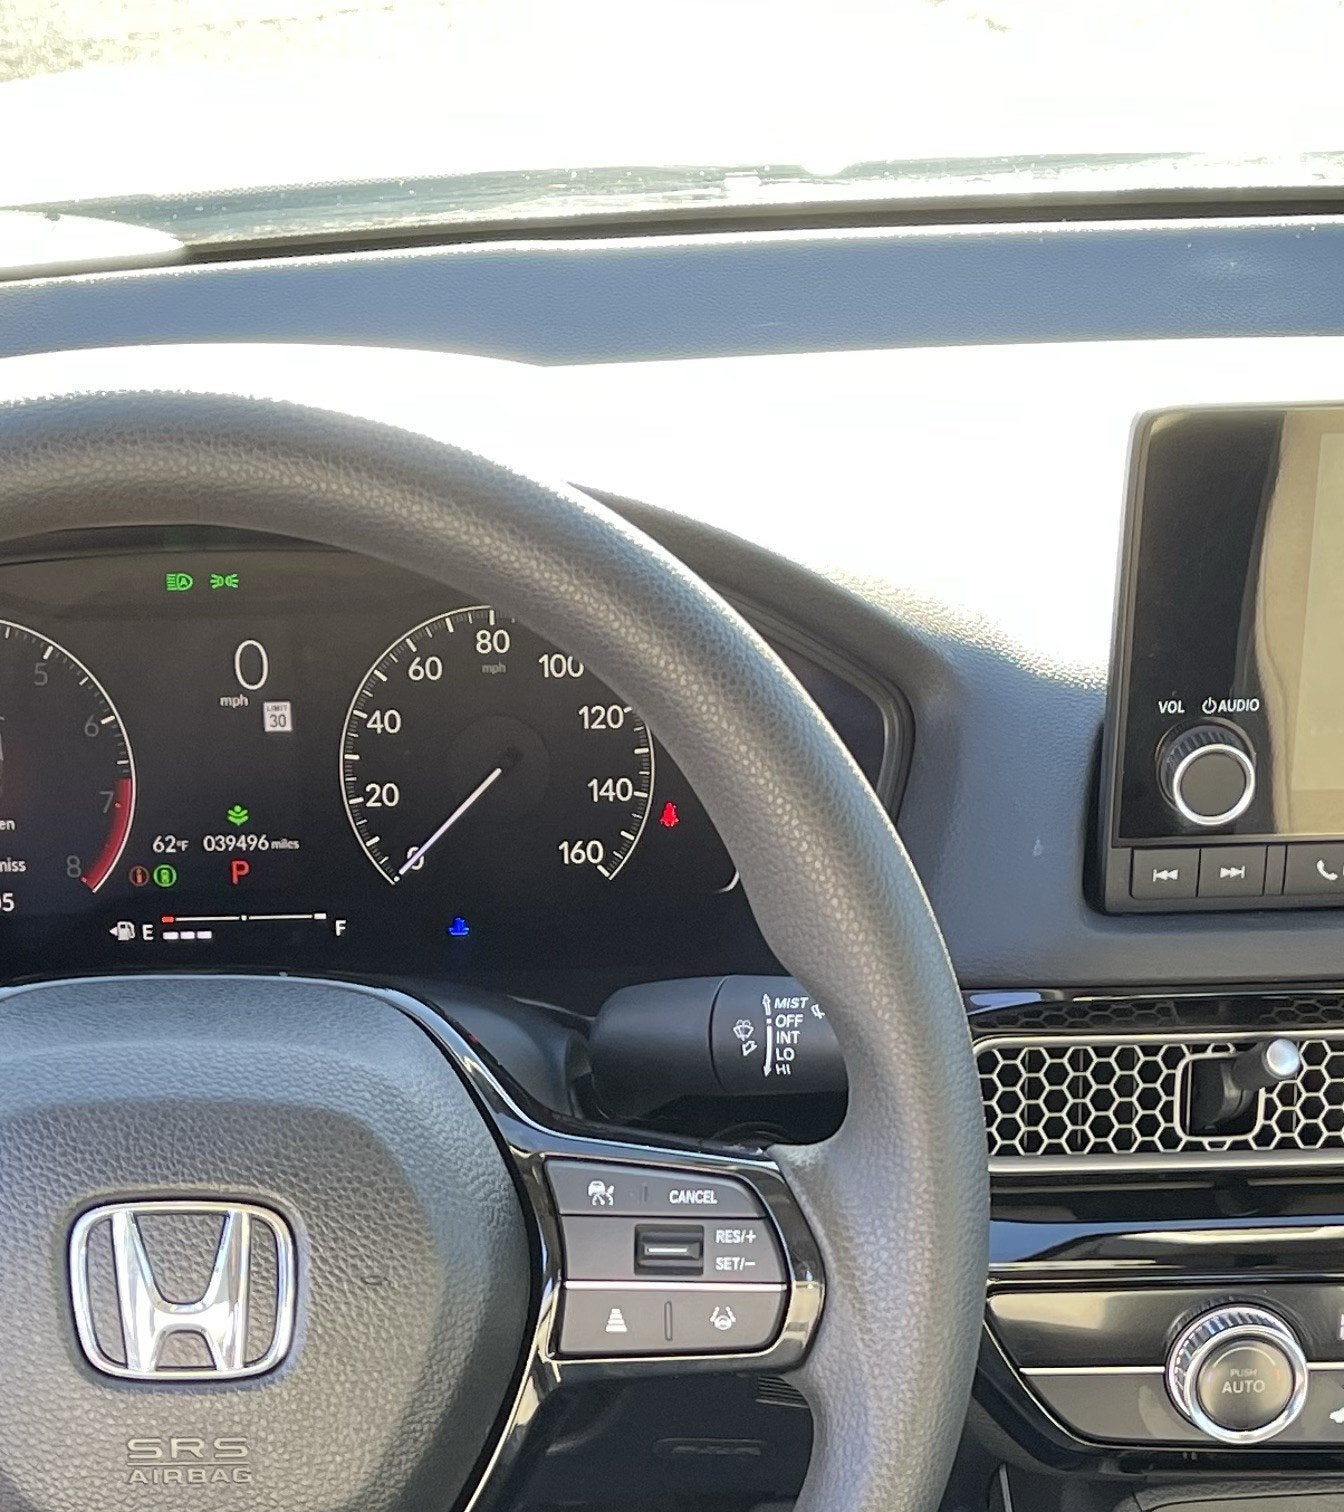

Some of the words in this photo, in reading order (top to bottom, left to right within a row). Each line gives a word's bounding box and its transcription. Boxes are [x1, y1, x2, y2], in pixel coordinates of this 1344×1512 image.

[475, 629, 510, 655] 80
[234, 639, 269, 690] 0
[408, 656, 443, 681] 60
[34, 664, 49, 687] 5
[219, 695, 249, 710] mph
[1158, 700, 1186, 714] VOL
[1218, 698, 1260, 713] AUDIO
[84, 715, 99, 738] 6
[269, 714, 287, 728] 30
[366, 711, 401, 735] 40
[578, 705, 624, 730] 120
[365, 784, 400, 808] 20
[587, 778, 633, 803] 140
[99, 791, 115, 813] 7
[203, 834, 270, 851] 039496
[271, 838, 300, 850] miles
[558, 840, 605, 866] 160
[66, 855, 82, 878] 8
[230, 860, 250, 884] P
[142, 924, 154, 940] E
[335, 919, 347, 937] F
[774, 997, 809, 1010] MIST
[775, 1014, 804, 1028] OFF
[776, 1031, 800, 1045] INT
[776, 1048, 795, 1061] LO
[776, 1064, 791, 1075] HI
[669, 1190, 718, 1204] CANCEL
[1230, 1368, 1258, 1378] PUSH
[1221, 1379, 1266, 1394] AUTO
[126, 1436, 251, 1460] SRS
[128, 1467, 253, 1486] AIRBAG
